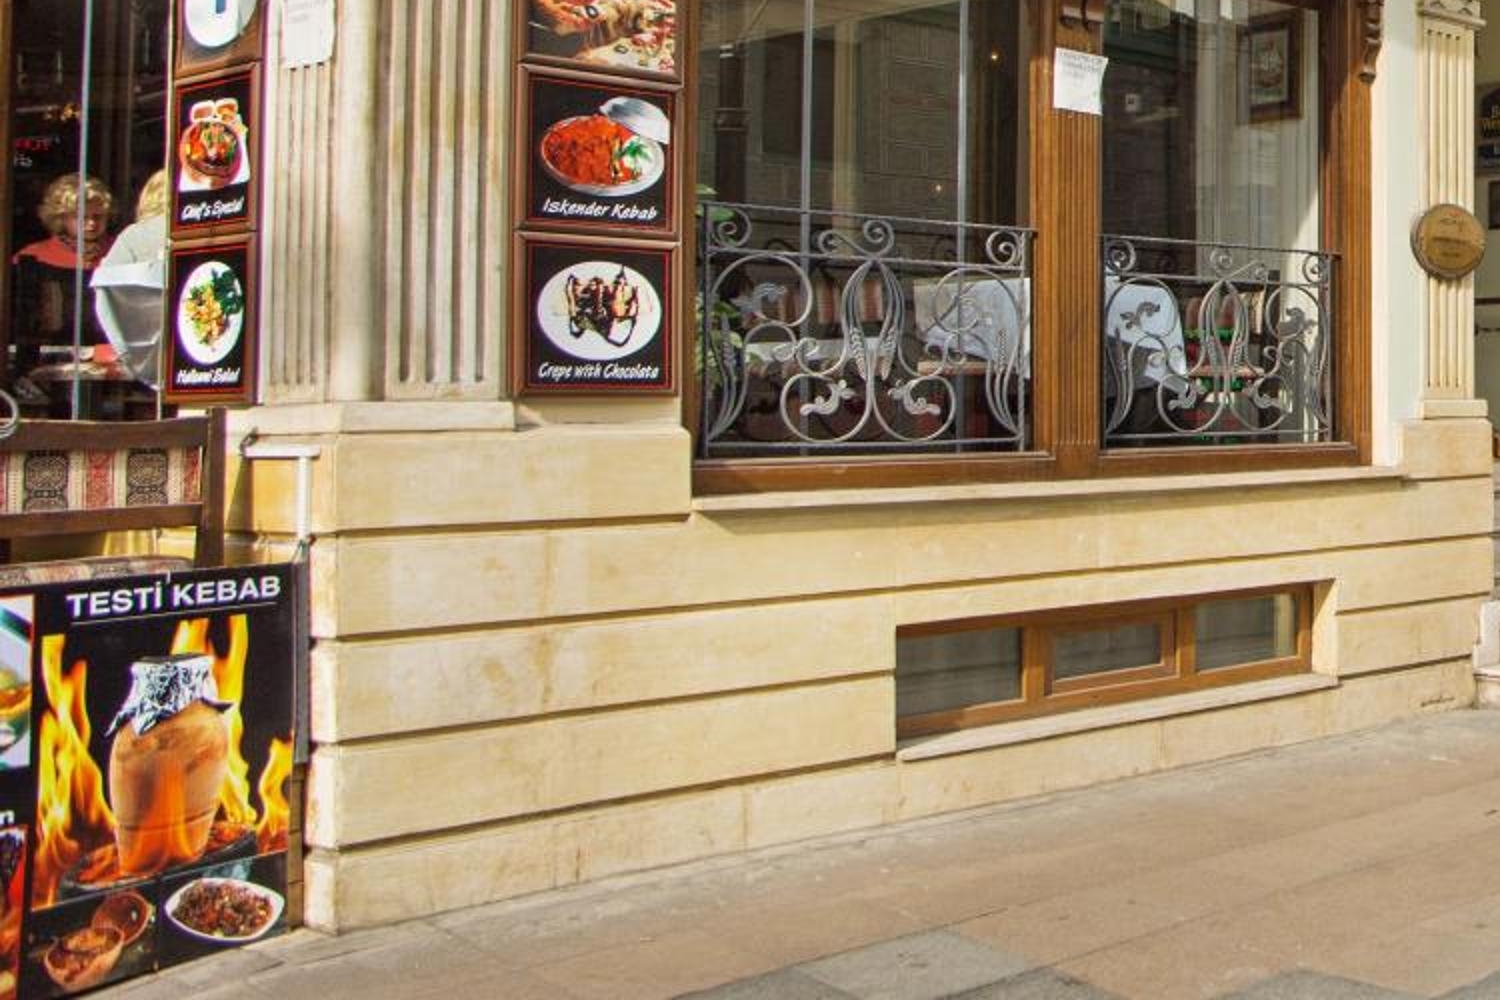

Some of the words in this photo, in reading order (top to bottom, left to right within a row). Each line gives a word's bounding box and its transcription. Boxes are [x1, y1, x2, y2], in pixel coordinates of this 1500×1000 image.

[542, 197, 610, 217] Iskender
[610, 203, 658, 220] Kebab
[173, 575, 281, 607] KEBAB
